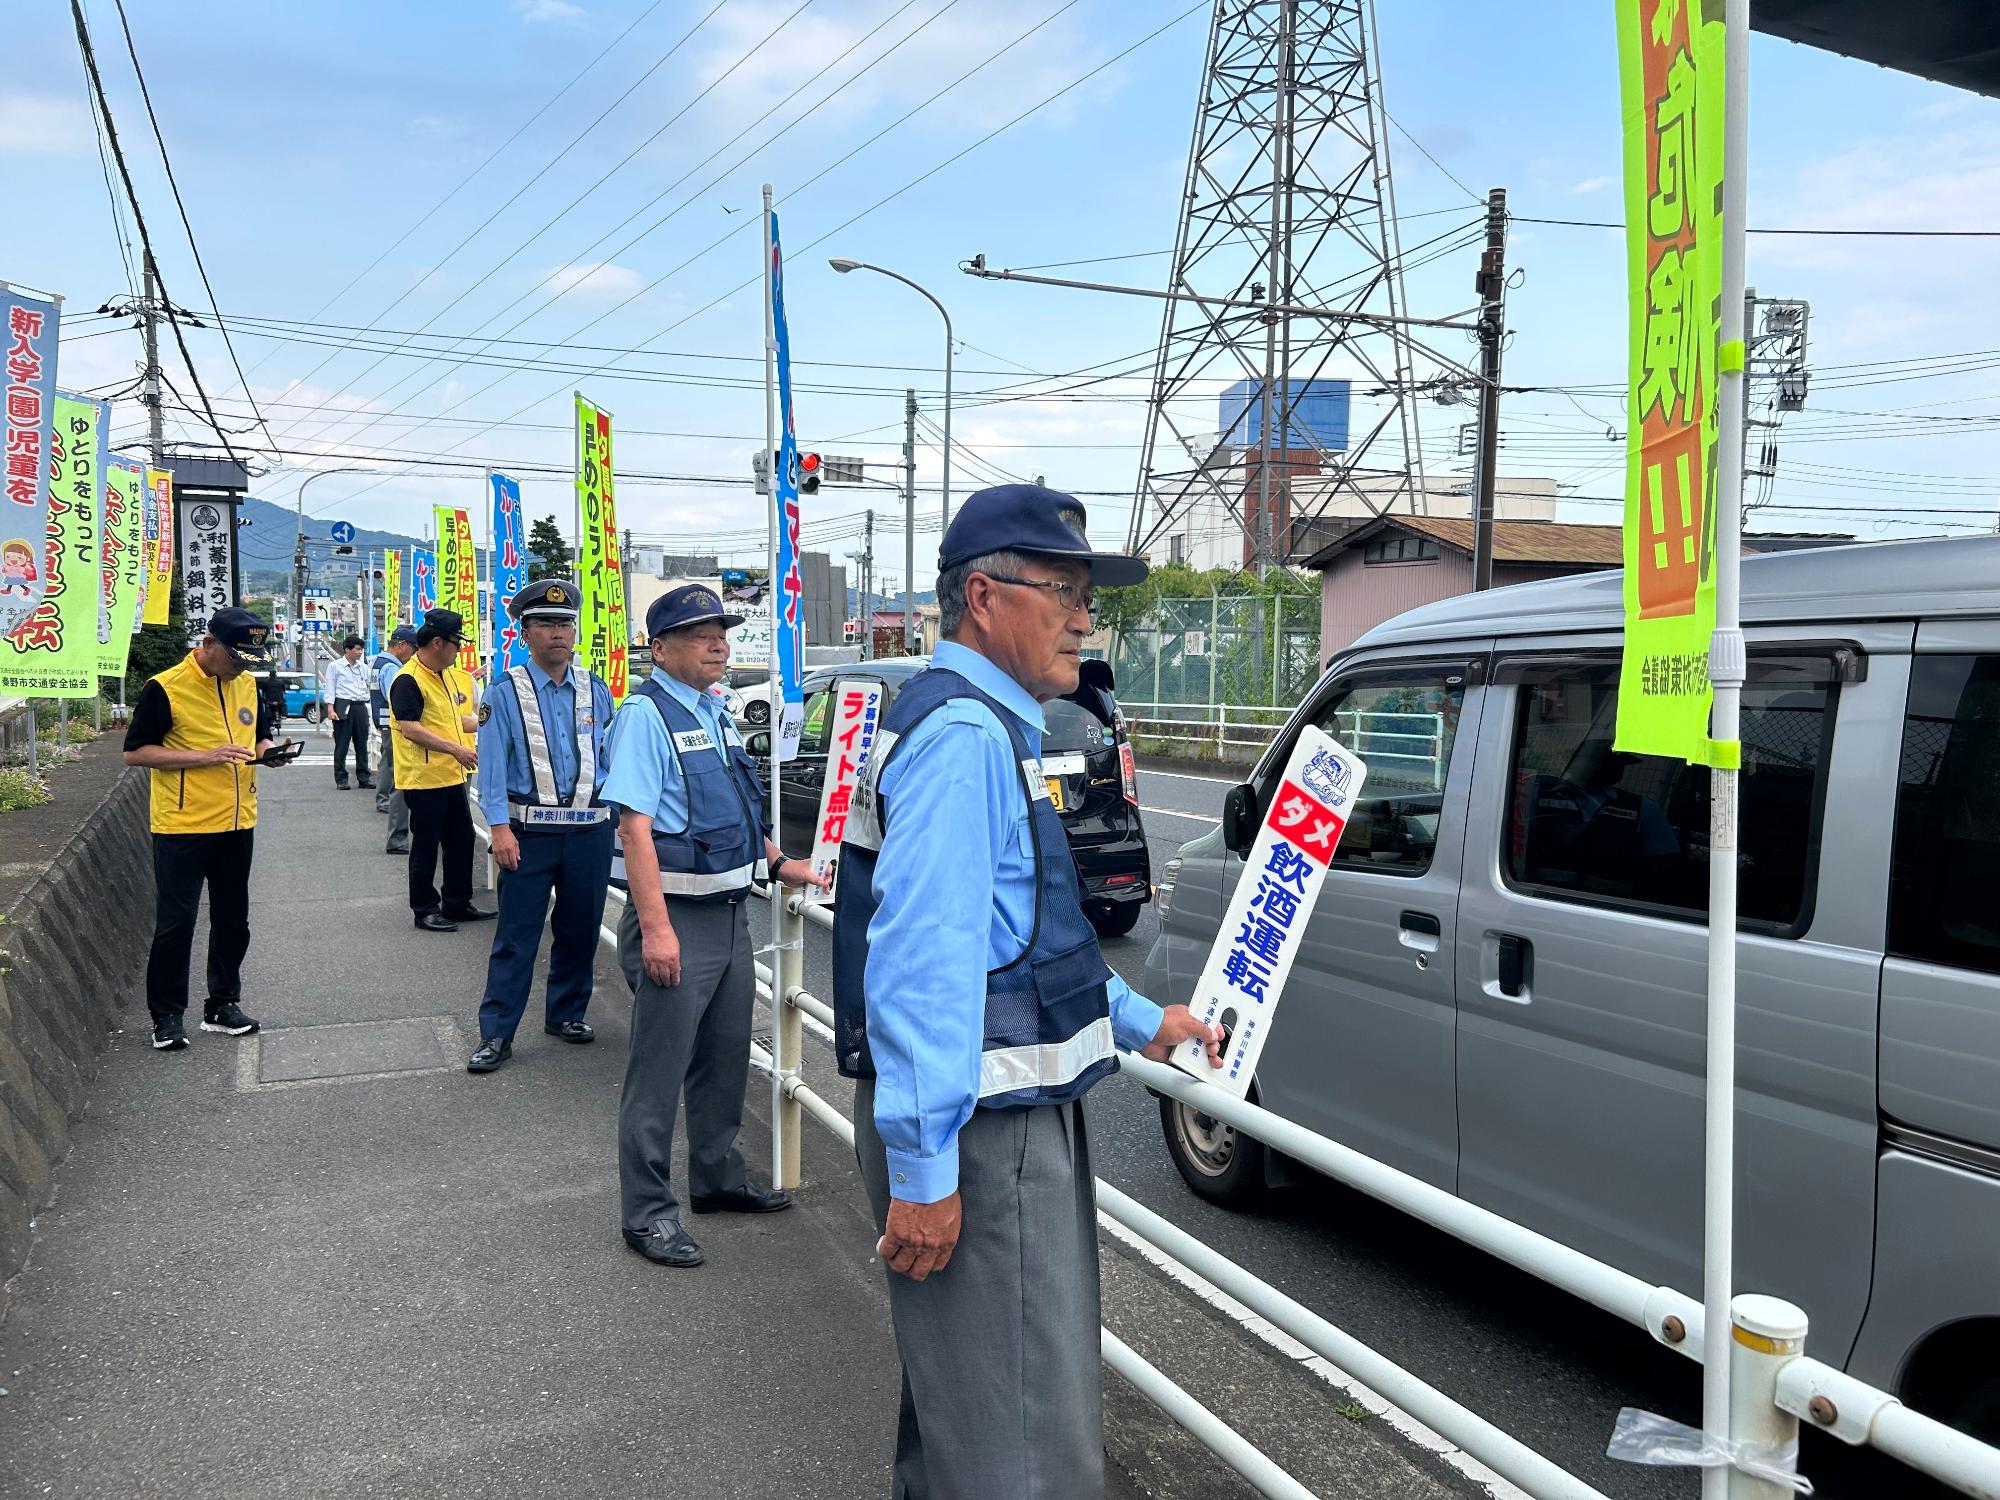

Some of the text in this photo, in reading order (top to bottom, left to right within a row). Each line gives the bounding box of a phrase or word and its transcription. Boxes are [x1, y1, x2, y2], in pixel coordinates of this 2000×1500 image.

[70, 417, 93, 563] ゆとりをもって
[125, 481, 140, 586] ゆとりをもって
[735, 607, 770, 618] 出雲大社
[2, 677, 89, 689] 秦野市交通安全協会
[822, 691, 865, 844] ライト点灯
[533, 809, 597, 822] 神奈川県警察
[1278, 795, 1338, 850] ダメ
[1222, 840, 1314, 1005] 飲酒運転
[1191, 996, 1219, 1058] 交通安協会
